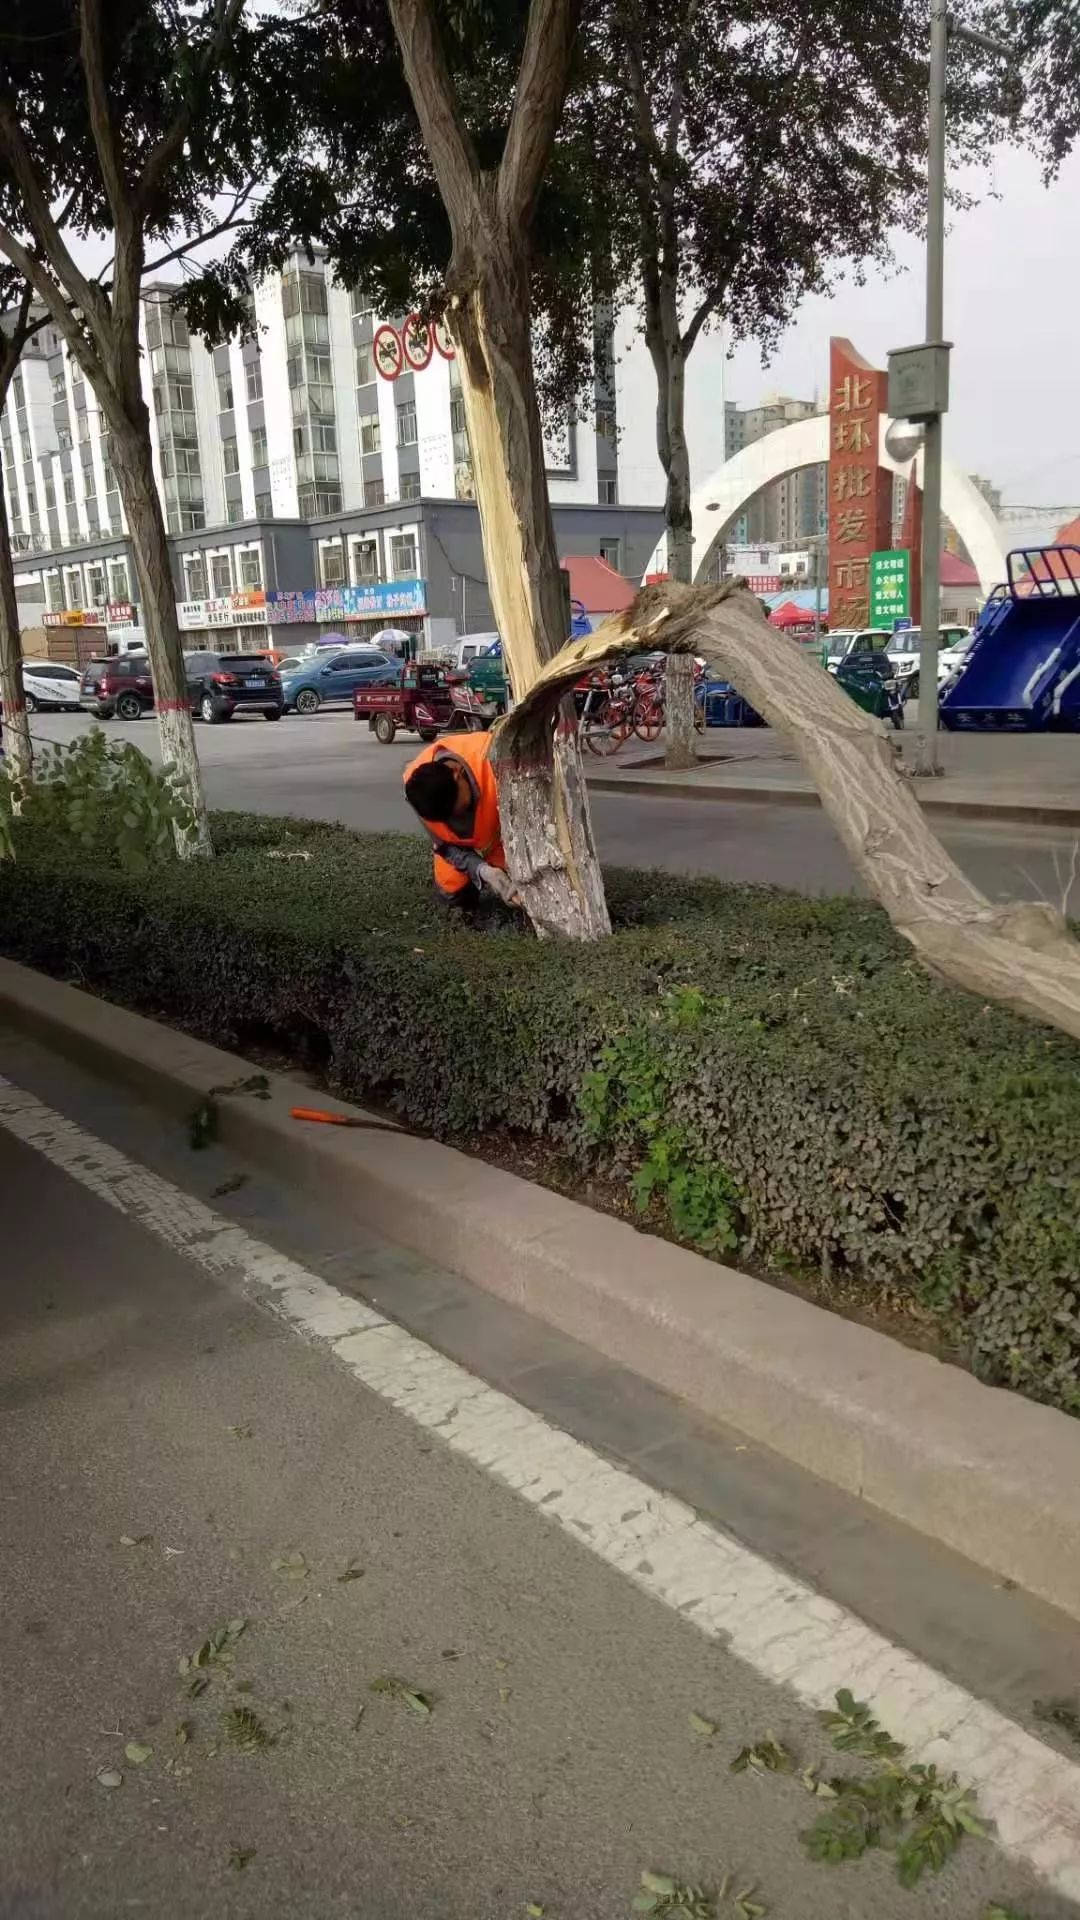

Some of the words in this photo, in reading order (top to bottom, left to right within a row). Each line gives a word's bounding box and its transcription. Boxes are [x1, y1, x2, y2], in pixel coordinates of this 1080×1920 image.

[833, 376, 873, 628] 北环批发市场
